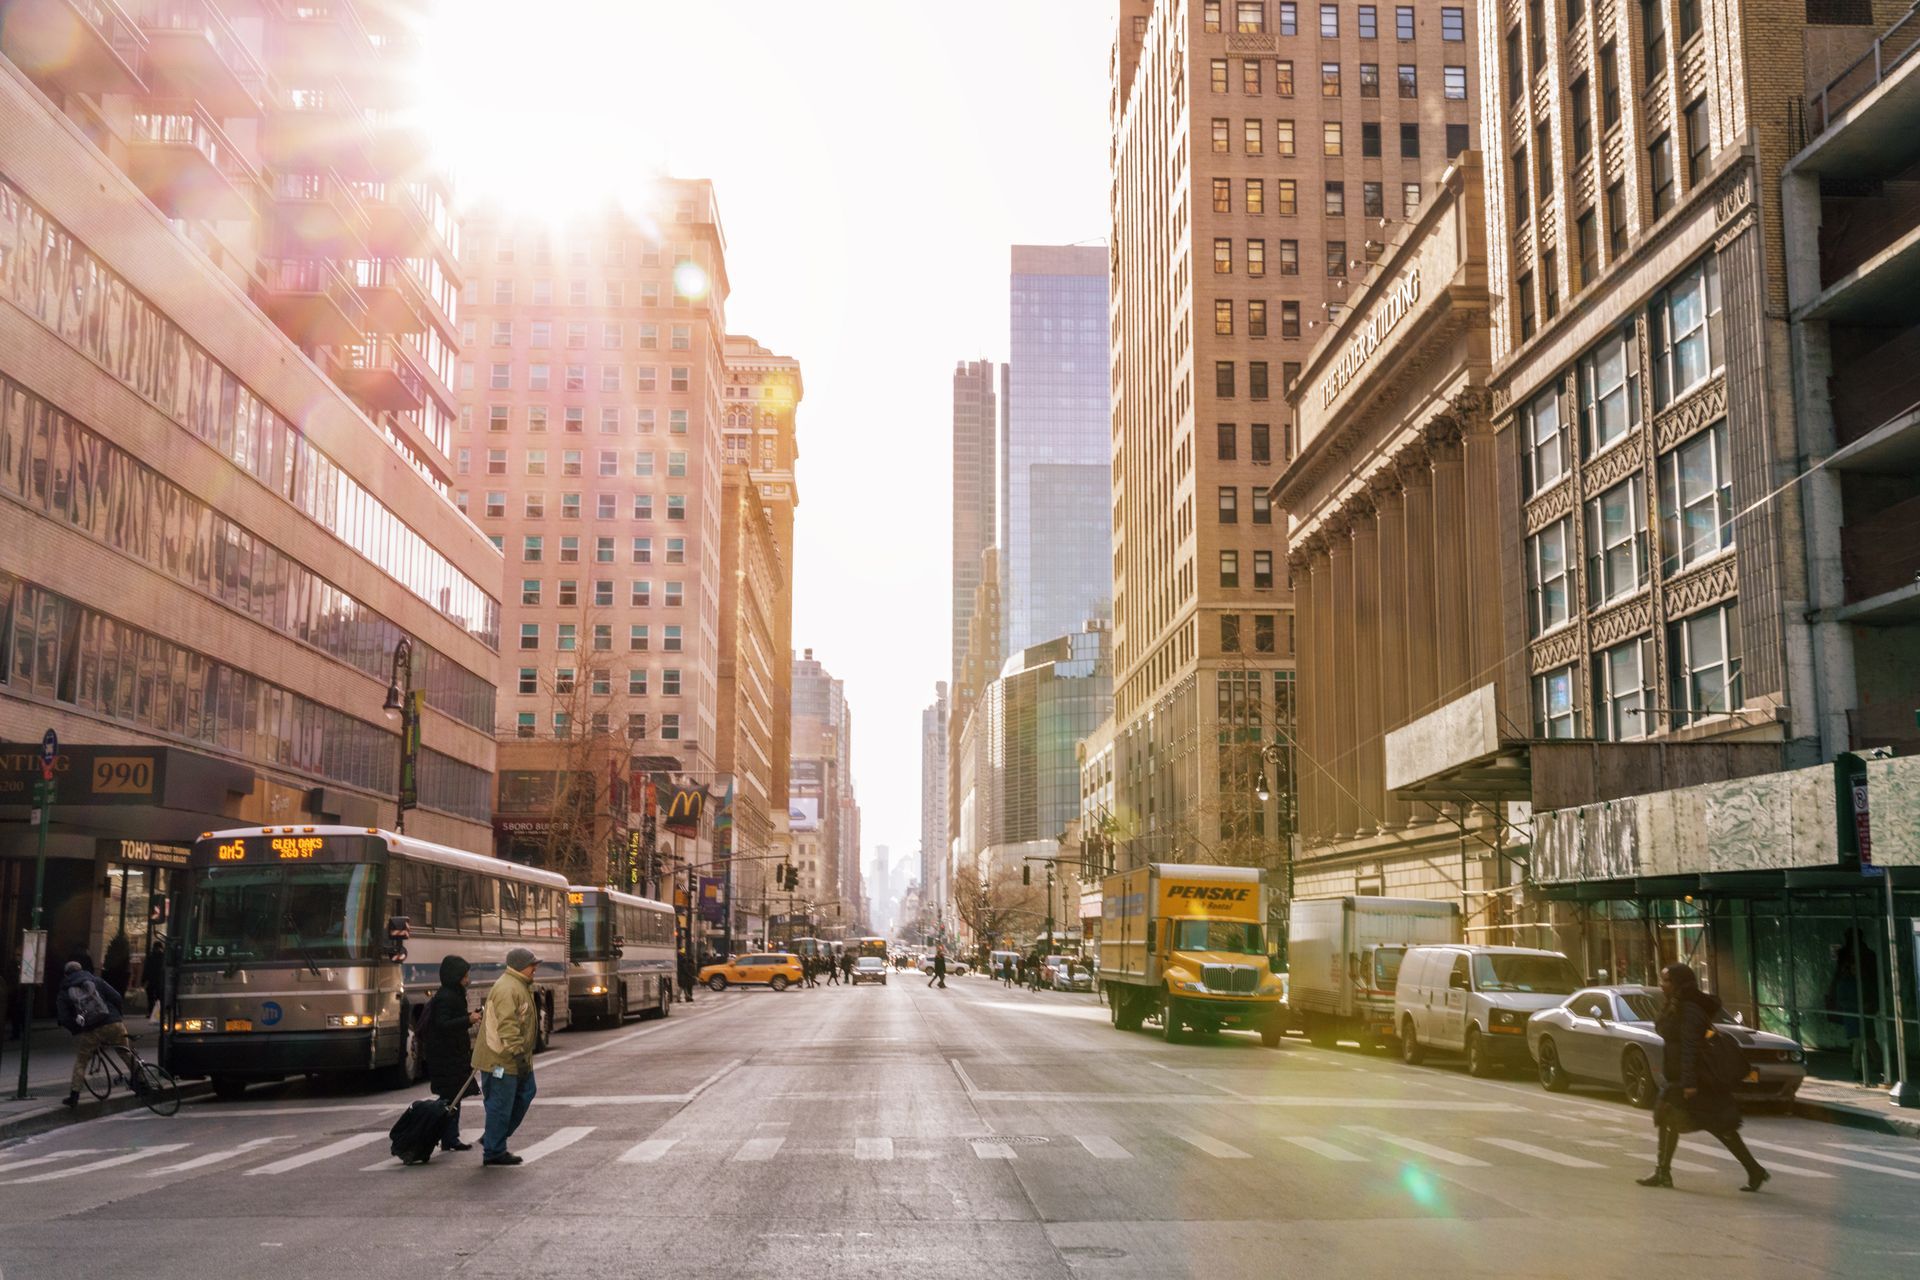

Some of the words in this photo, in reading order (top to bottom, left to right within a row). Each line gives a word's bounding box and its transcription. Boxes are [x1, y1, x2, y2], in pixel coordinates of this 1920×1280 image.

[1321, 368, 1340, 411] THE
[1339, 333, 1370, 391] HAIER
[1368, 269, 1421, 355] BUILDING
[97, 762, 149, 788] 990
[121, 840, 151, 861] TOHO
[219, 839, 245, 860] QM5
[271, 837, 297, 850] GLEN
[297, 837, 323, 849] OAKS
[300, 847, 314, 858] ST
[1167, 885, 1251, 902] PENSKE
